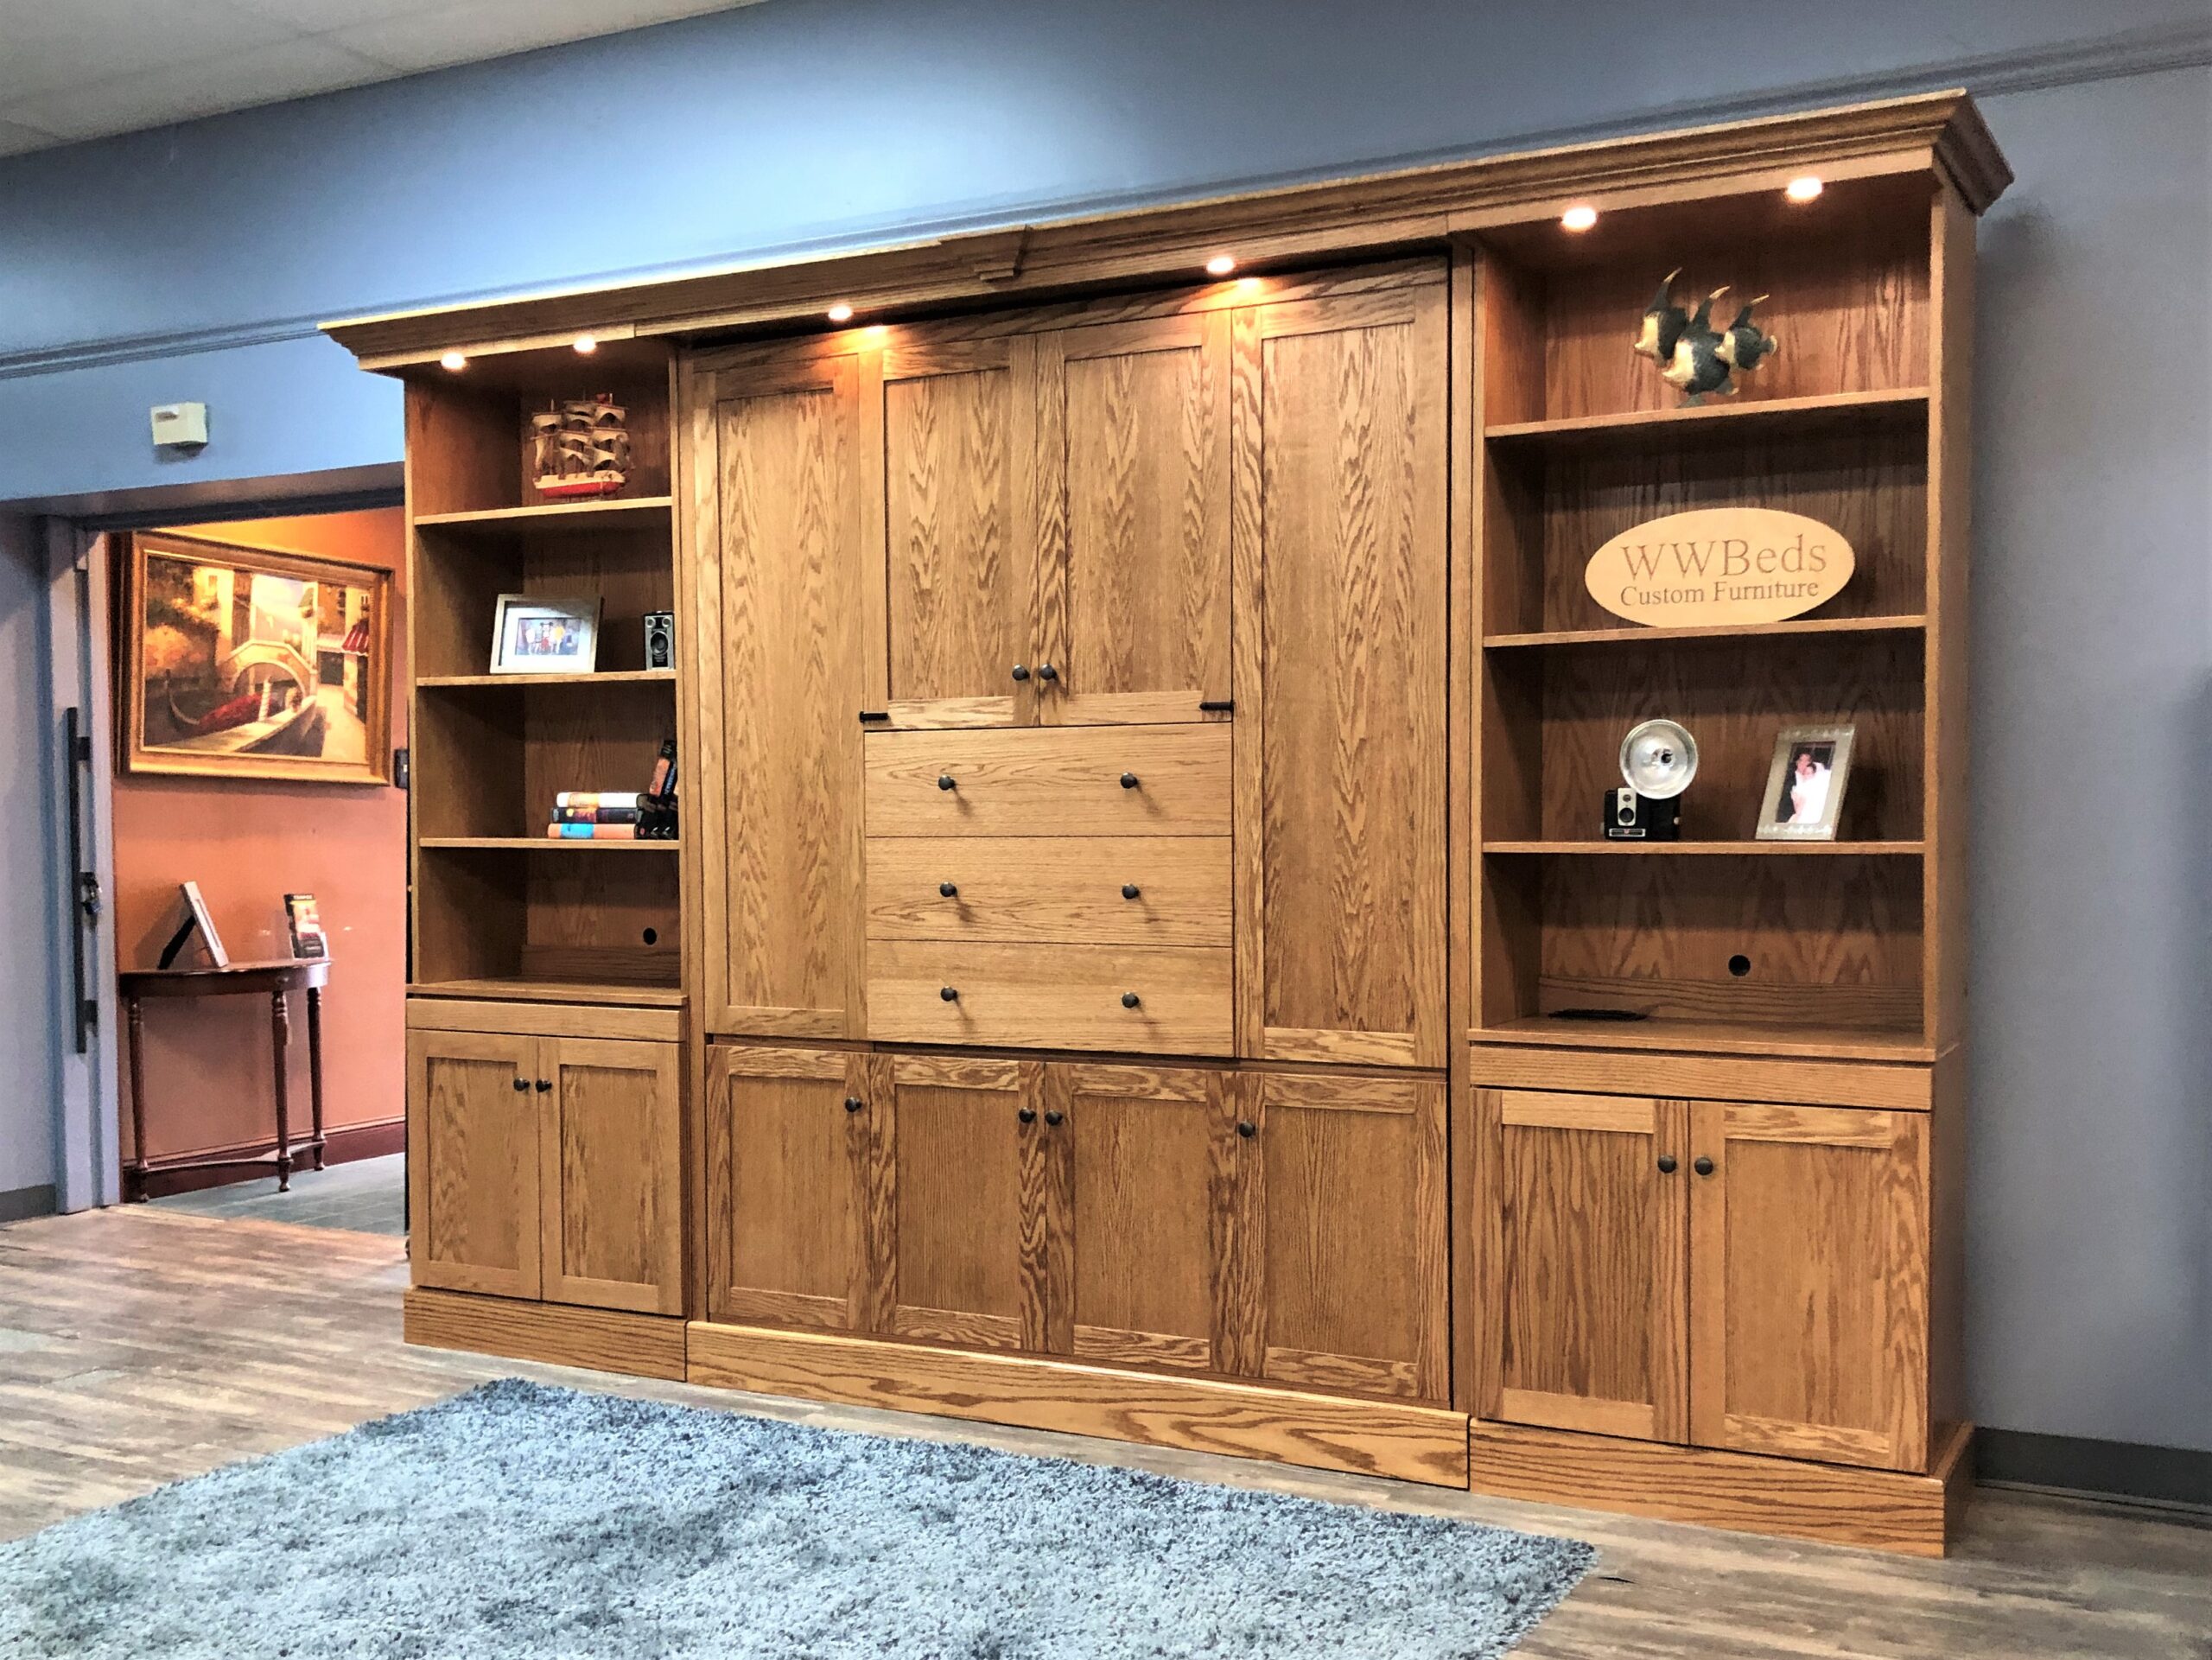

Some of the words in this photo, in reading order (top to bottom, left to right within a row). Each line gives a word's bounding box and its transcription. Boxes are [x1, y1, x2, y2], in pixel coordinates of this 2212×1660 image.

[1621, 534, 1827, 581] WWBeds
[1620, 585, 1705, 607] Custom
[1713, 580, 1819, 602] Furniture
